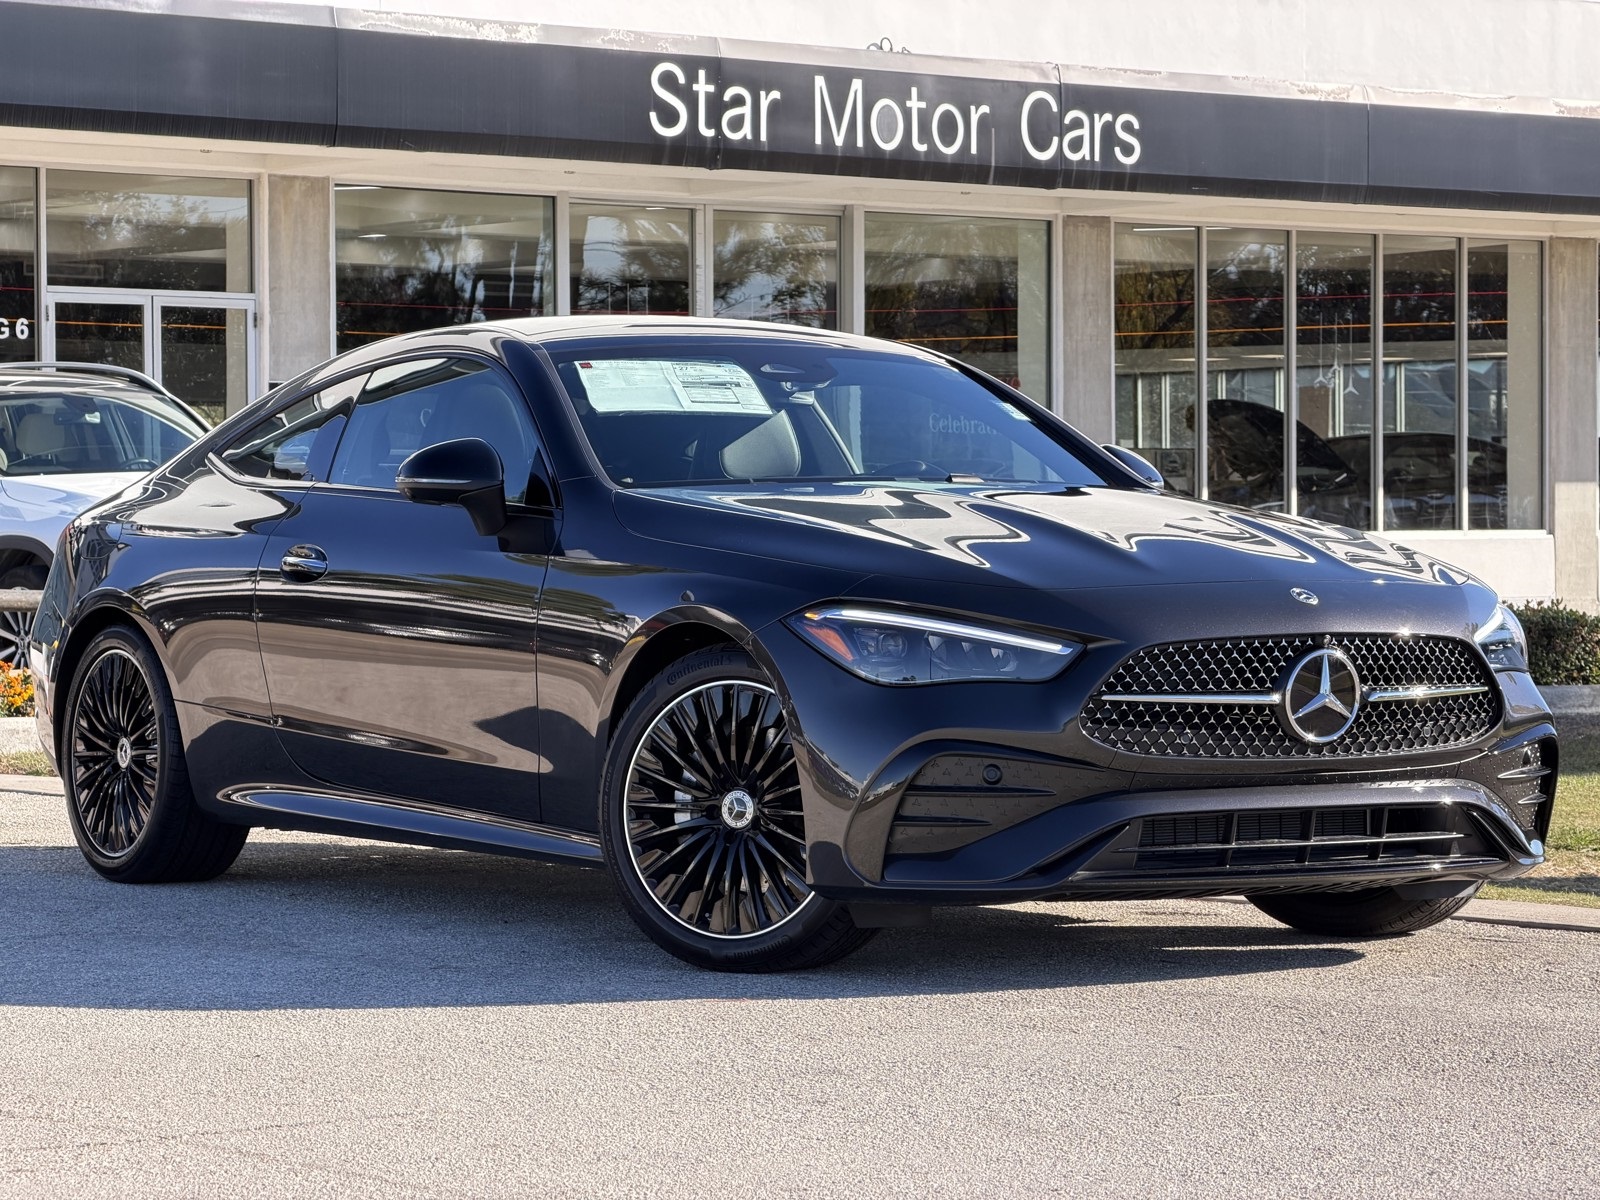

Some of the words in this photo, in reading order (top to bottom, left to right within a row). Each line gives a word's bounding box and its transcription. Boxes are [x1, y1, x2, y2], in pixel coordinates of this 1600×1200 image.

[649, 62, 780, 141] Star
[814, 75, 989, 155] Motor
[1021, 90, 1140, 165] Cars
[16, 317, 29, 340] 6
[667, 655, 724, 686] Continental
